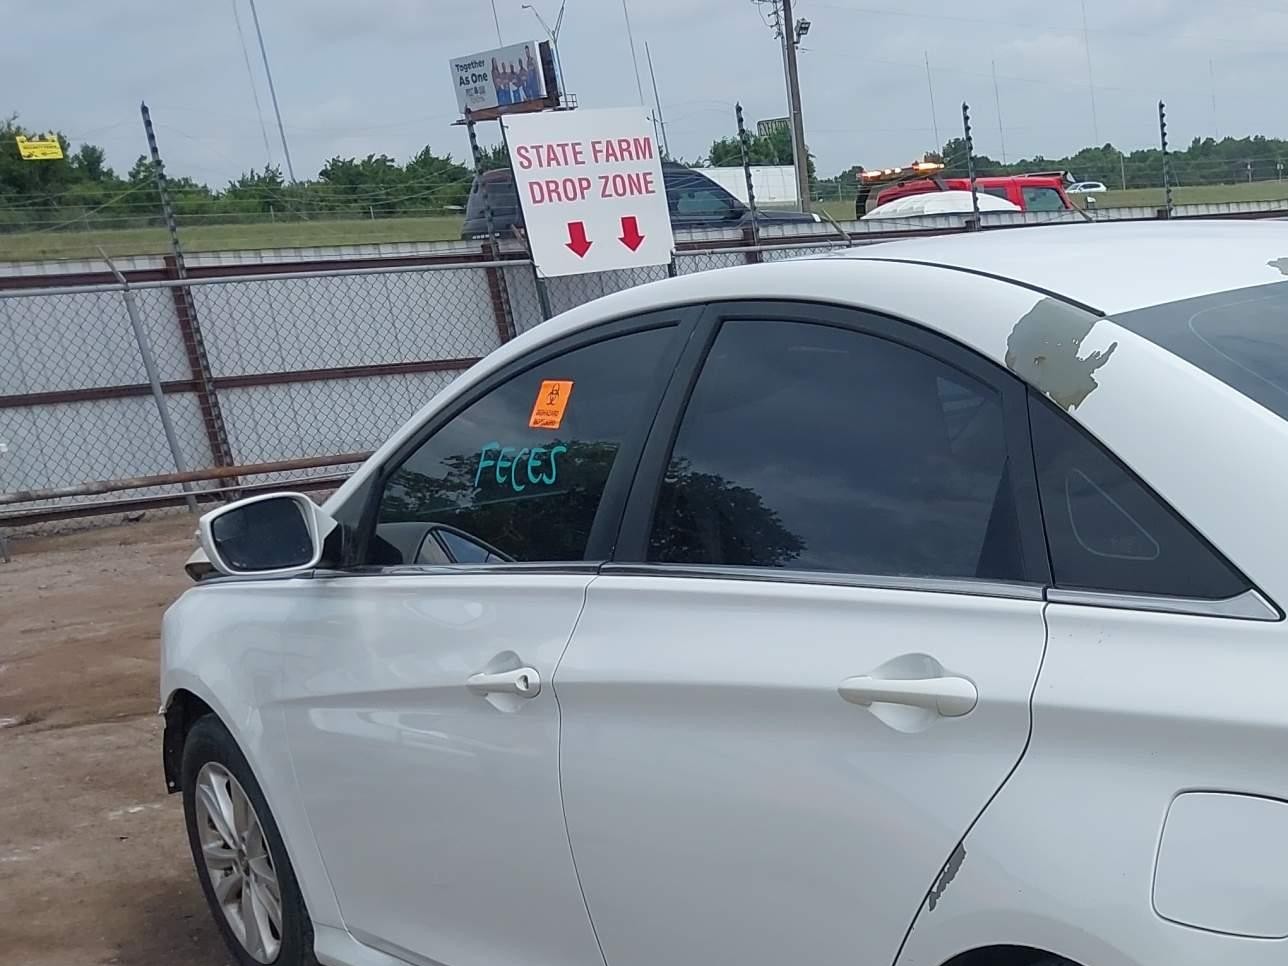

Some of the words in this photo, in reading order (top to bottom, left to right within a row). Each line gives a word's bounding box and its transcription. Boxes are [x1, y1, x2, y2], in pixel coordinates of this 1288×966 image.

[455, 59, 485, 73] Together
[459, 75, 470, 87] As
[471, 72, 489, 83] One
[516, 142, 585, 170] STATE
[591, 136, 653, 163] FARM
[528, 176, 592, 204] DROP
[598, 172, 656, 199] ZONE
[475, 441, 567, 492] FECES
